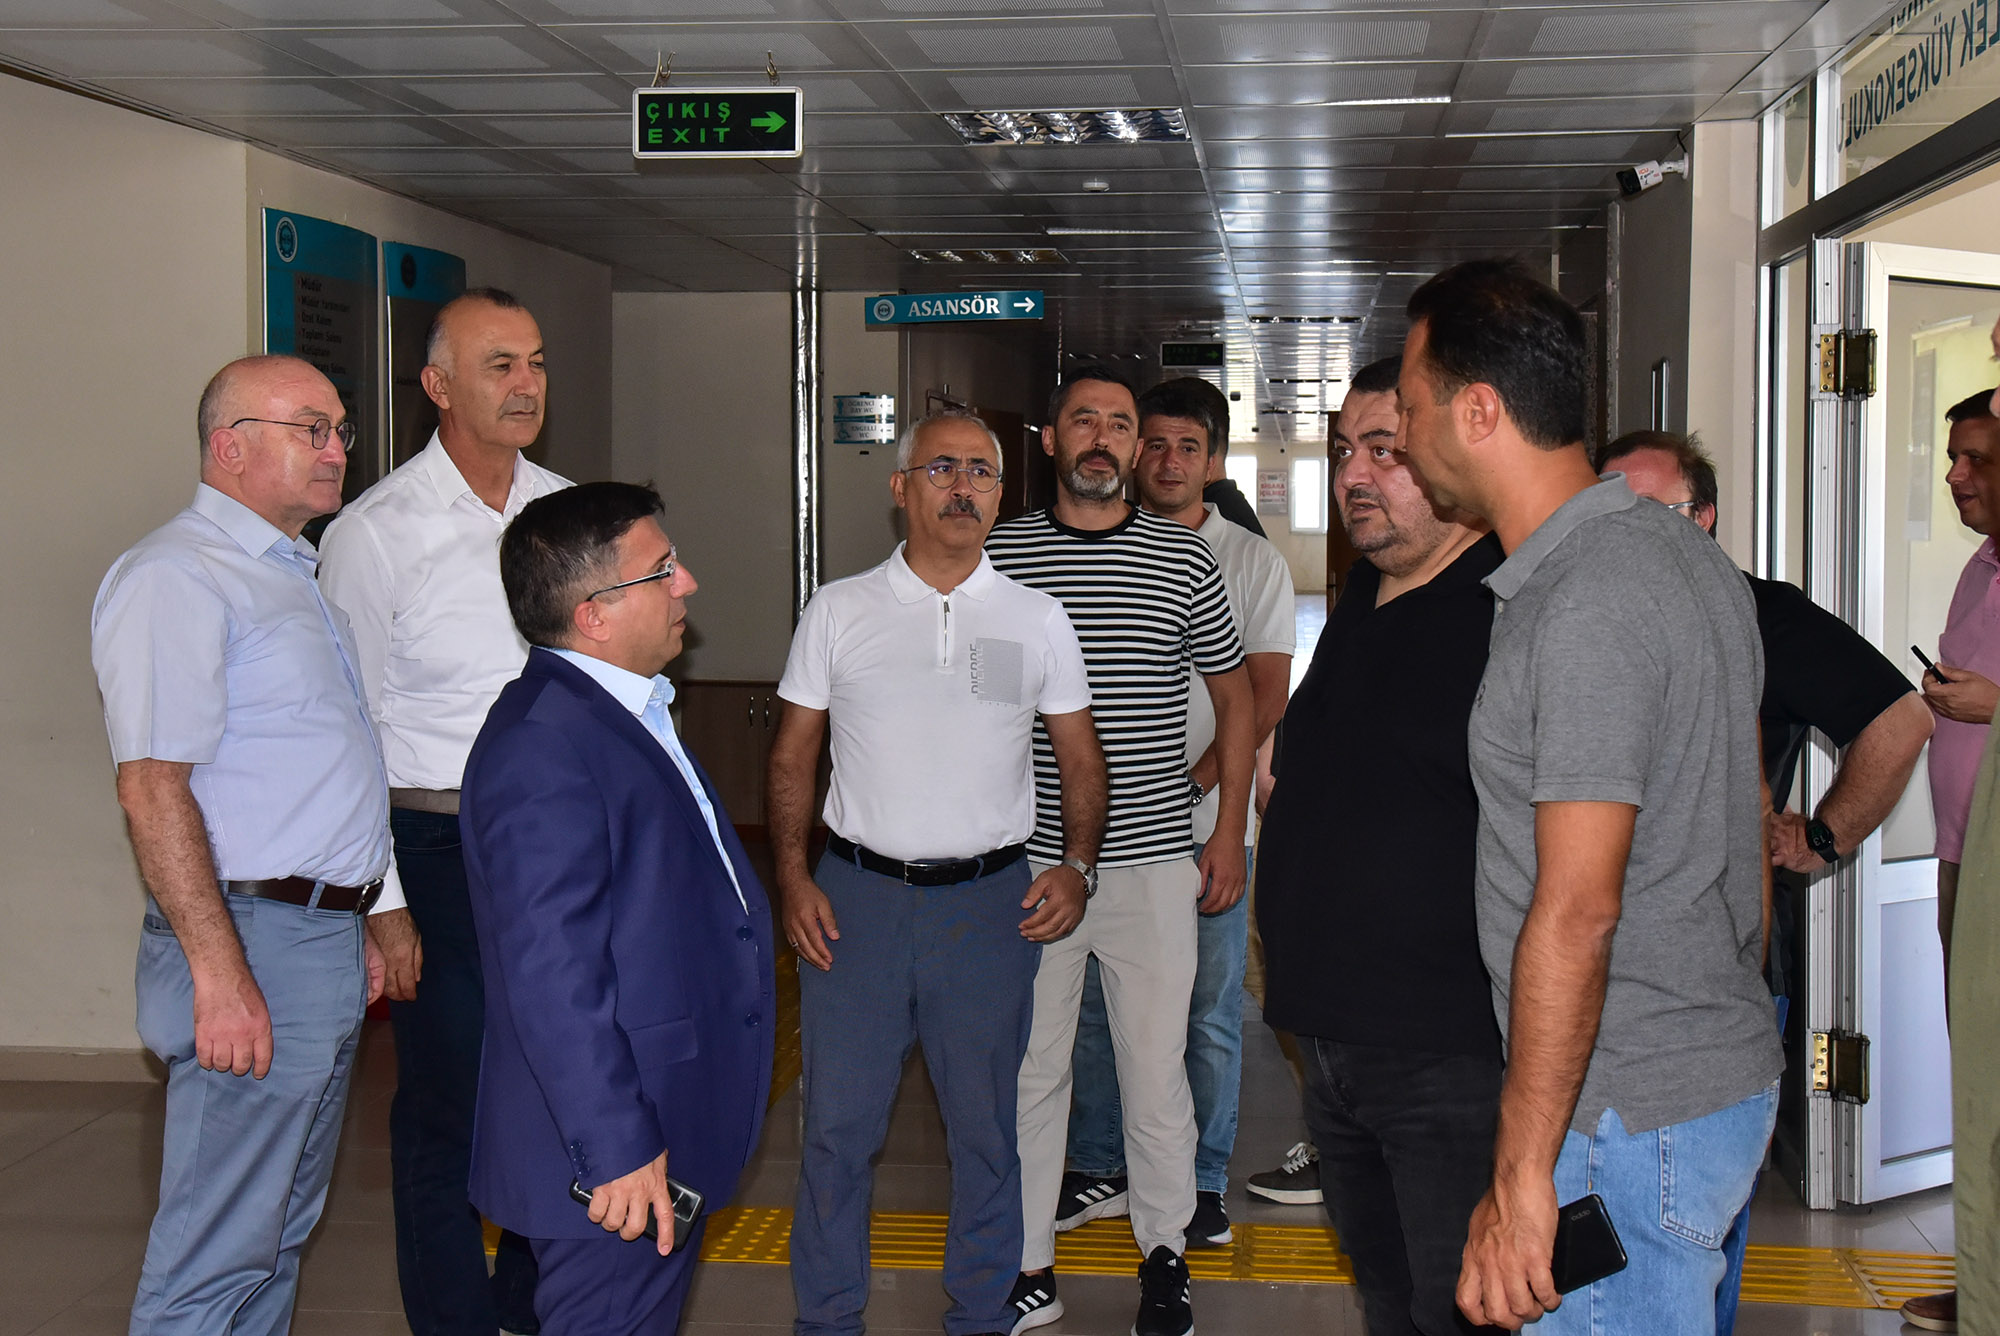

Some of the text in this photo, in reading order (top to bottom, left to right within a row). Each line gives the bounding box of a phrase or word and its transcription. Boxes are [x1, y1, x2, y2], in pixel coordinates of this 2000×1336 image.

[646, 102, 731, 124] ÇIKIŞ
[648, 128, 731, 144] EXIT
[908, 295, 1001, 317] ASANSÖR
